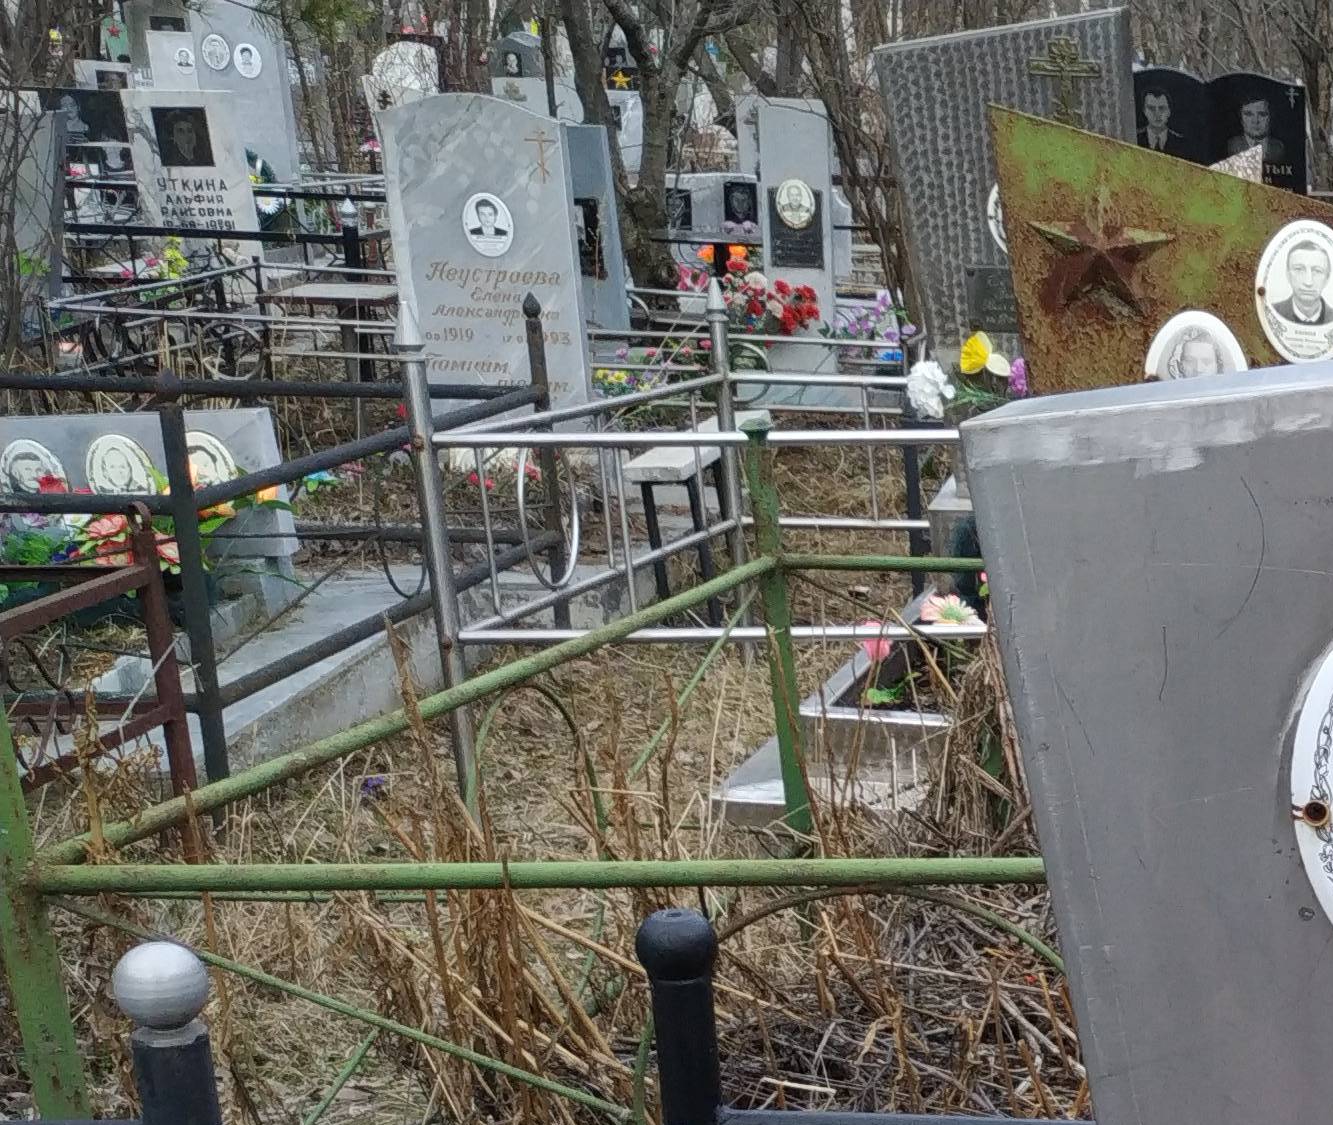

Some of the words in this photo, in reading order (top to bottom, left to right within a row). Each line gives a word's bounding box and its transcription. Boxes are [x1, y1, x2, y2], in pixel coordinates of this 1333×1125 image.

[156, 177, 228, 192] УТКИНА
[166, 194, 225, 205] АЛЬФИЯ
[160, 206, 233, 218] РАИСОВНА
[425, 261, 562, 289] Неустроева
